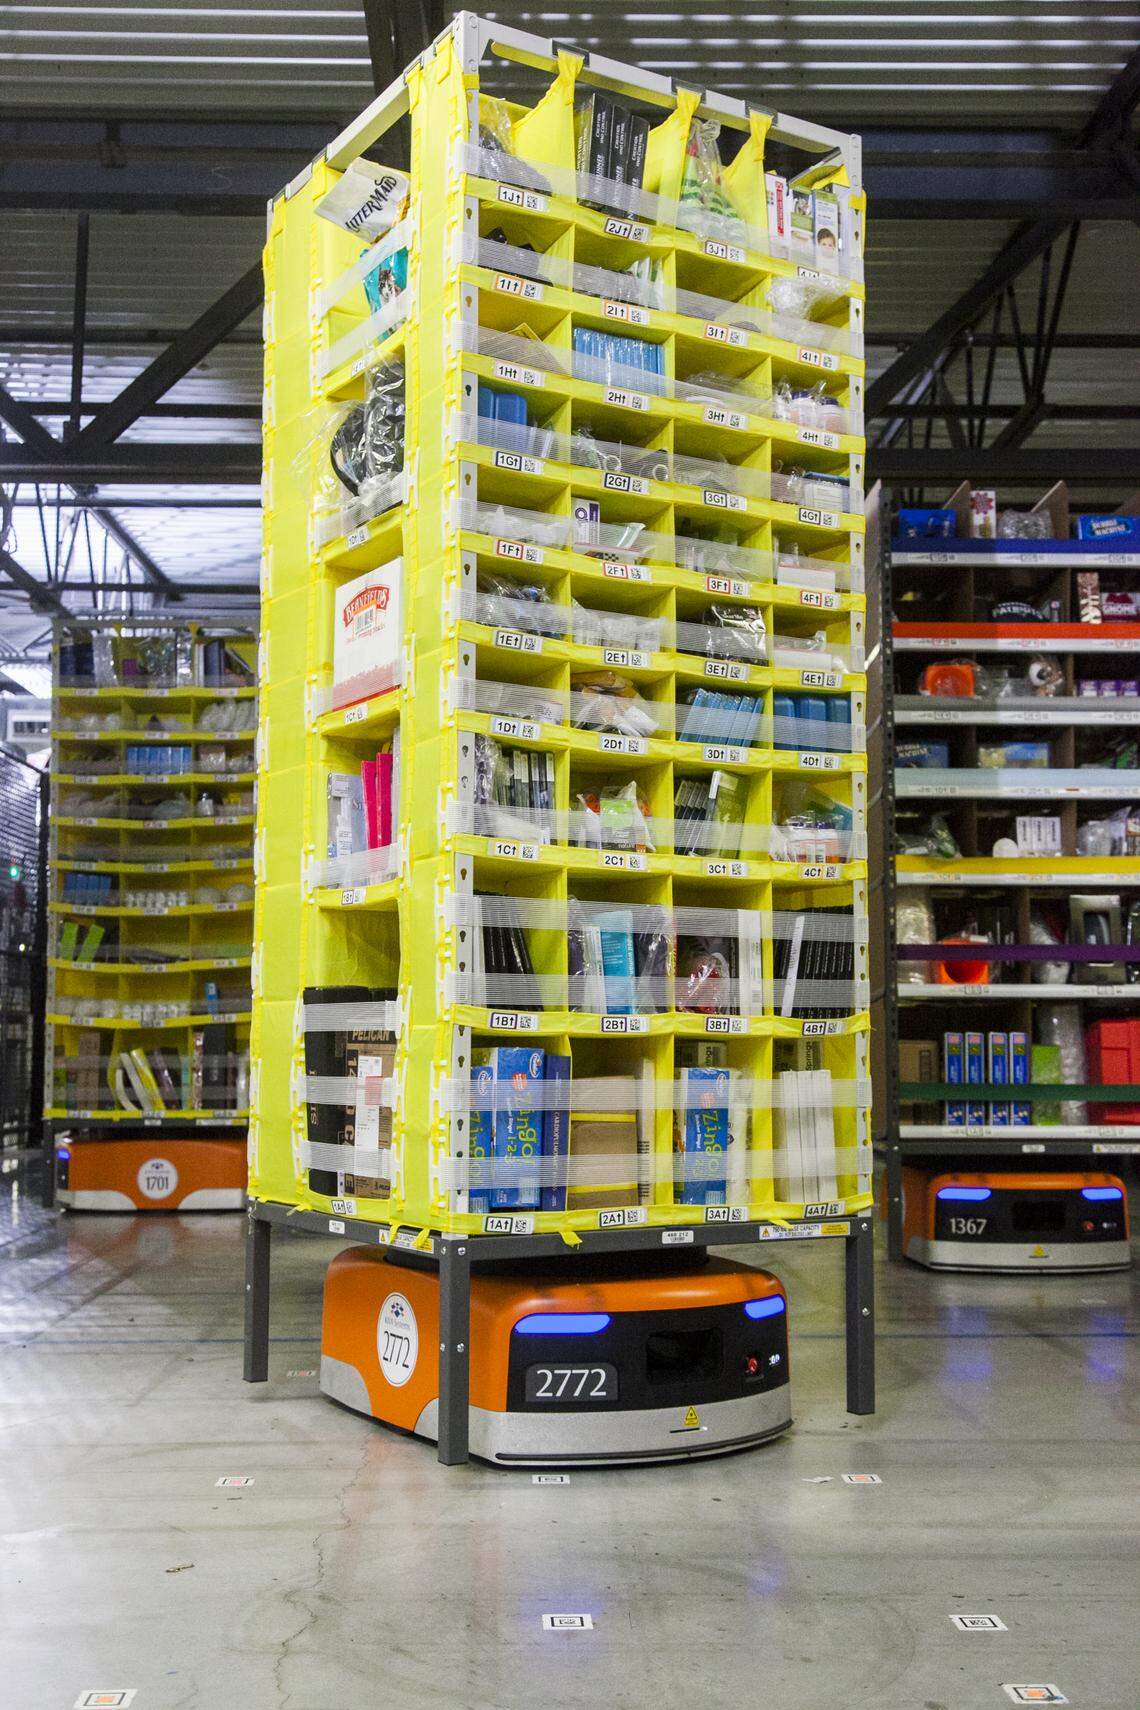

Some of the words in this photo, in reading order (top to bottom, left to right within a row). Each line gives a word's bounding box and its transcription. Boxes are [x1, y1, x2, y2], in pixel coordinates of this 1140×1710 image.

[502, 190, 516, 202] 1J
[608, 222, 621, 234] 2J
[708, 242, 720, 255] 3J
[498, 366, 513, 377] 1H
[608, 392, 622, 403] 2H
[707, 410, 721, 421] 3H
[802, 432, 814, 442] 4H
[499, 454, 514, 465] 1G
[608, 476, 622, 487] 2G
[707, 493, 720, 504] 3G
[802, 510, 814, 521] 4G
[501, 544, 514, 555] 1F
[607, 565, 620, 575] 2F
[710, 580, 722, 590] 3F
[803, 593, 815, 603] 4F
[499, 634, 514, 645] 1E
[607, 652, 620, 662] 2E
[707, 664, 720, 674] 3E
[804, 673, 816, 683] 4E
[497, 722, 512, 732] 1D
[604, 739, 618, 749] 2D
[707, 749, 720, 759] 3D
[802, 756, 815, 766] 4D
[497, 845, 512, 855] 1C
[604, 855, 619, 865] 2C
[708, 864, 722, 874] 3C
[804, 868, 818, 877] 4C
[495, 1015, 509, 1027] 1B
[604, 1019, 620, 1030] 2B
[709, 1020, 722, 1030] 3B
[805, 1024, 818, 1033] 4B
[146, 1176, 169, 1190] 1701
[708, 1208, 722, 1220] 3A
[808, 1204, 820, 1215] 4A
[603, 1212, 617, 1223] 2A
[489, 1219, 504, 1230] 1A
[950, 1218, 987, 1234] 1367
[383, 1330, 410, 1368] 2772
[536, 1368, 606, 1397] 2772
